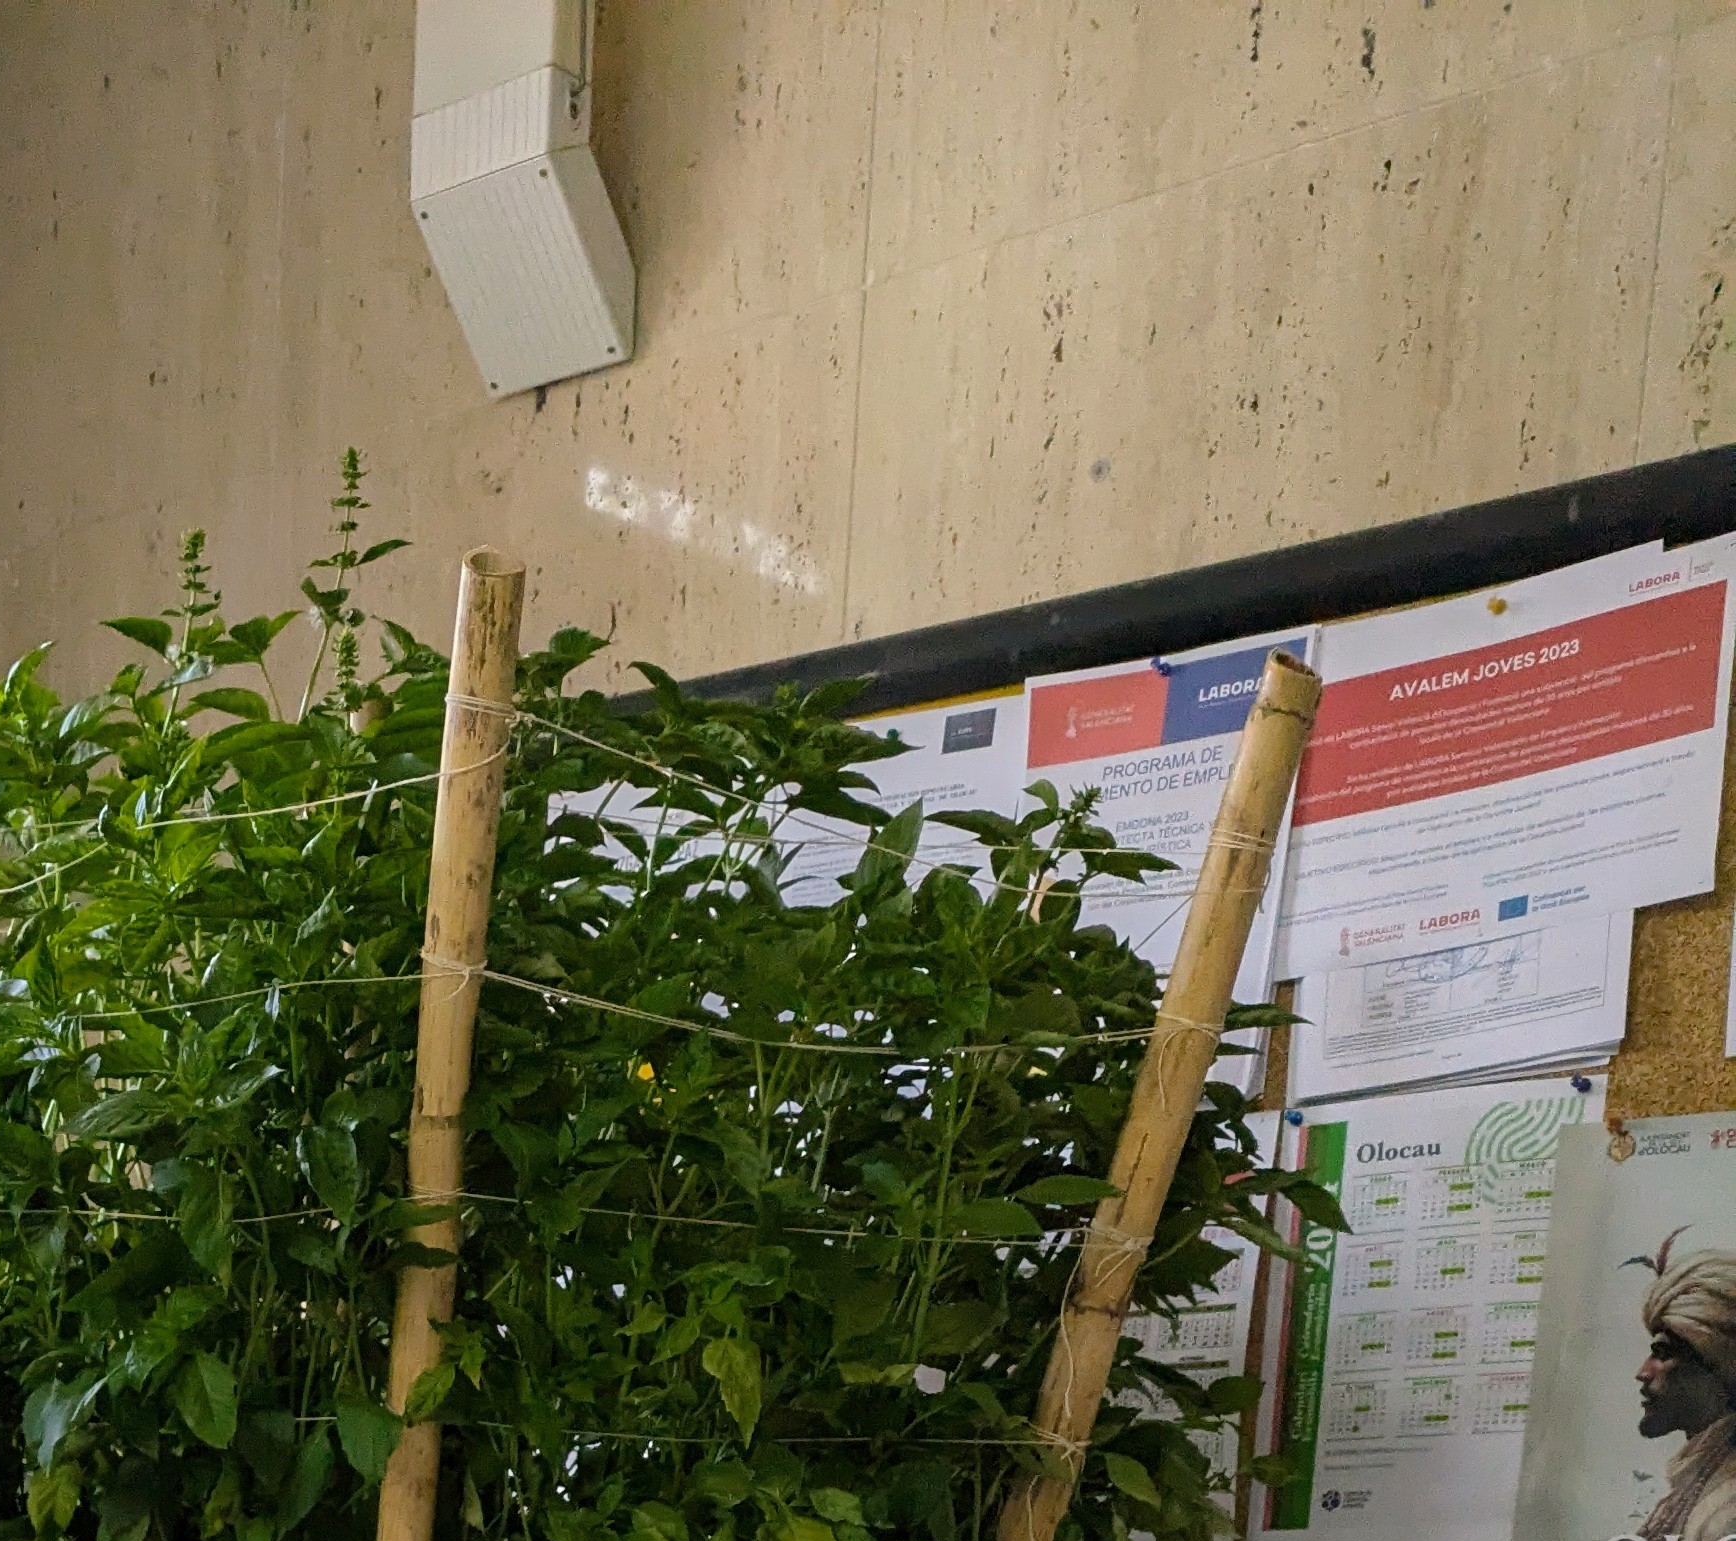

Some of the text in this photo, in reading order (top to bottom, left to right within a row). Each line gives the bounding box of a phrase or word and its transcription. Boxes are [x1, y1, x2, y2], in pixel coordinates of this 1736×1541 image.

[1629, 572, 1680, 592] LABORA
[1388, 638, 1581, 701] AVALEM JOVES 2023
[1102, 744, 1223, 779] PROGRAMA DE
[1163, 774, 1181, 792] DE
[1419, 909, 1480, 930] LABORA
[1356, 1142, 1441, 1163] Olocau
